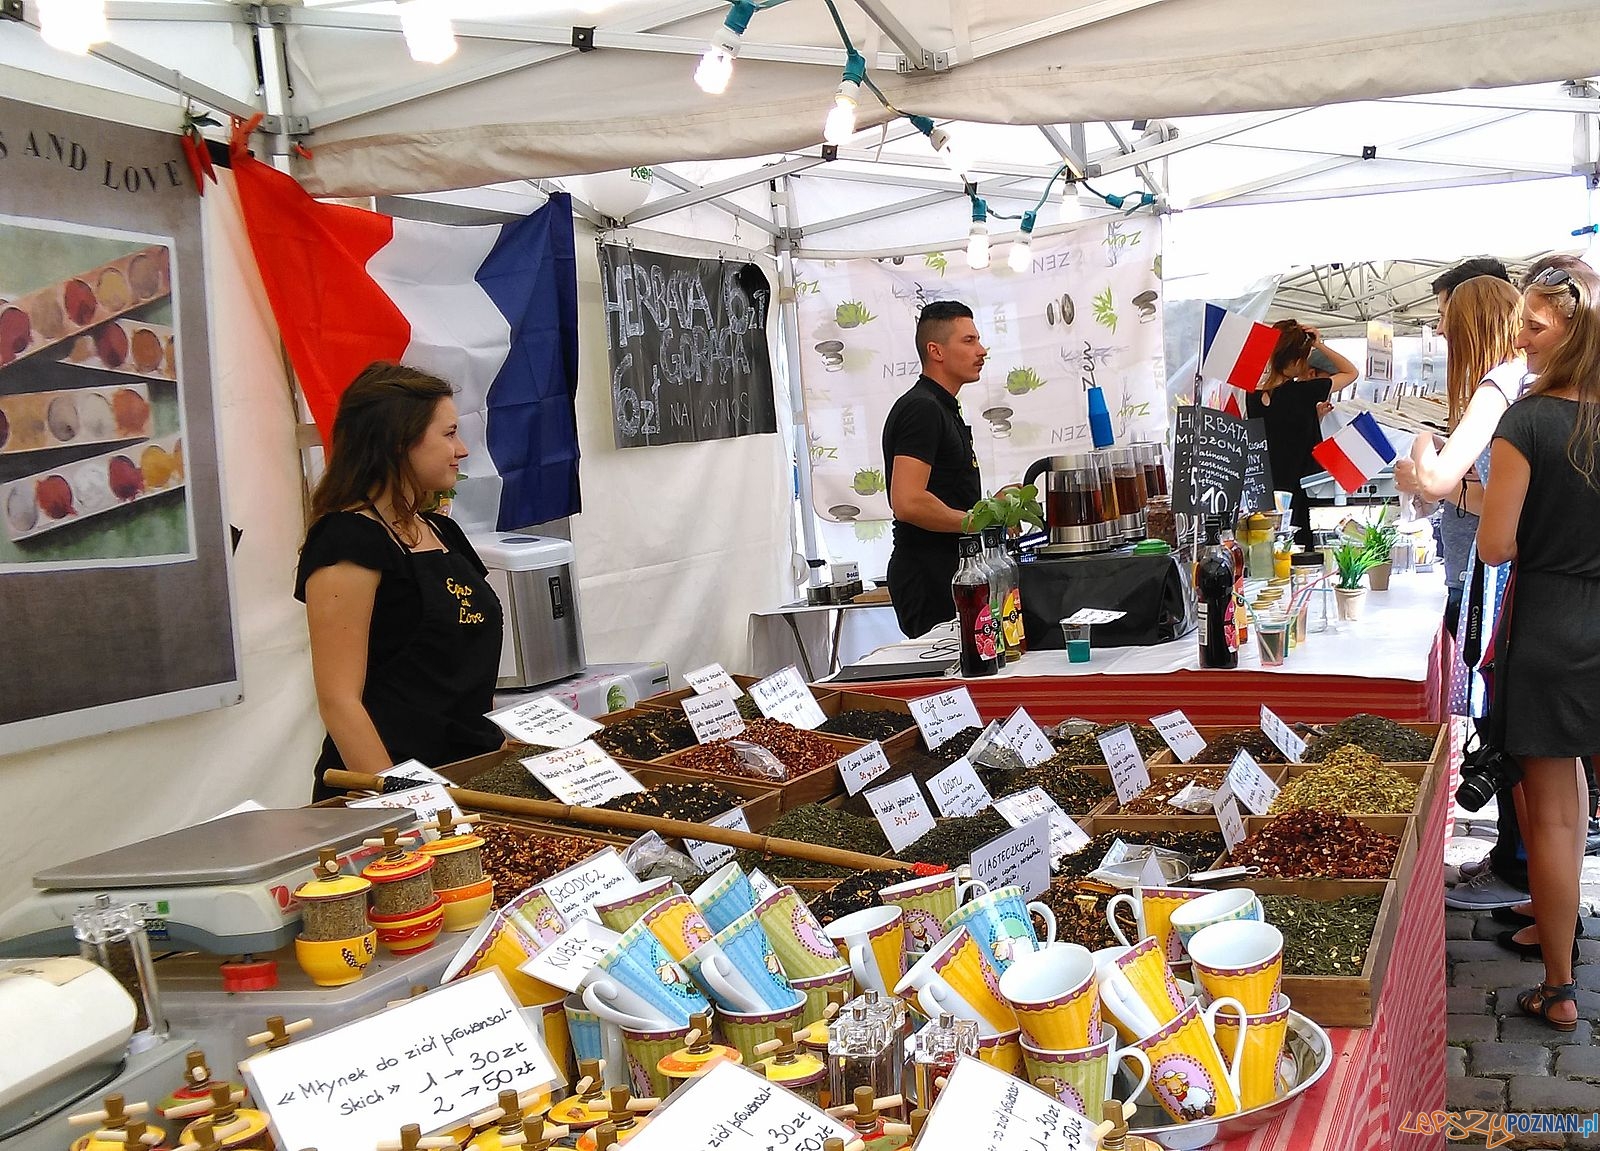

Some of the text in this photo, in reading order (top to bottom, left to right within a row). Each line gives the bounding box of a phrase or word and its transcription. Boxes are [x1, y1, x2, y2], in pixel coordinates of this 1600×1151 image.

[24, 131, 87, 171] AND
[102, 160, 183, 193] LOVE
[1033, 252, 1070, 274] ZEN
[603, 261, 714, 350] HERBATA
[882, 361, 920, 379] ZEN
[670, 401, 690, 427] NA
[1051, 423, 1088, 444] ZEN
[1178, 412, 1249, 447] HRBATA
[459, 606, 485, 624] Love
[1470, 605, 1480, 640] Canon
[977, 835, 1036, 877] CIASTECZKOWA
[543, 937, 588, 971] KUBEK
[376, 1056, 399, 1071] do
[340, 1089, 384, 1116] skich
[434, 1096, 454, 1115] 2
